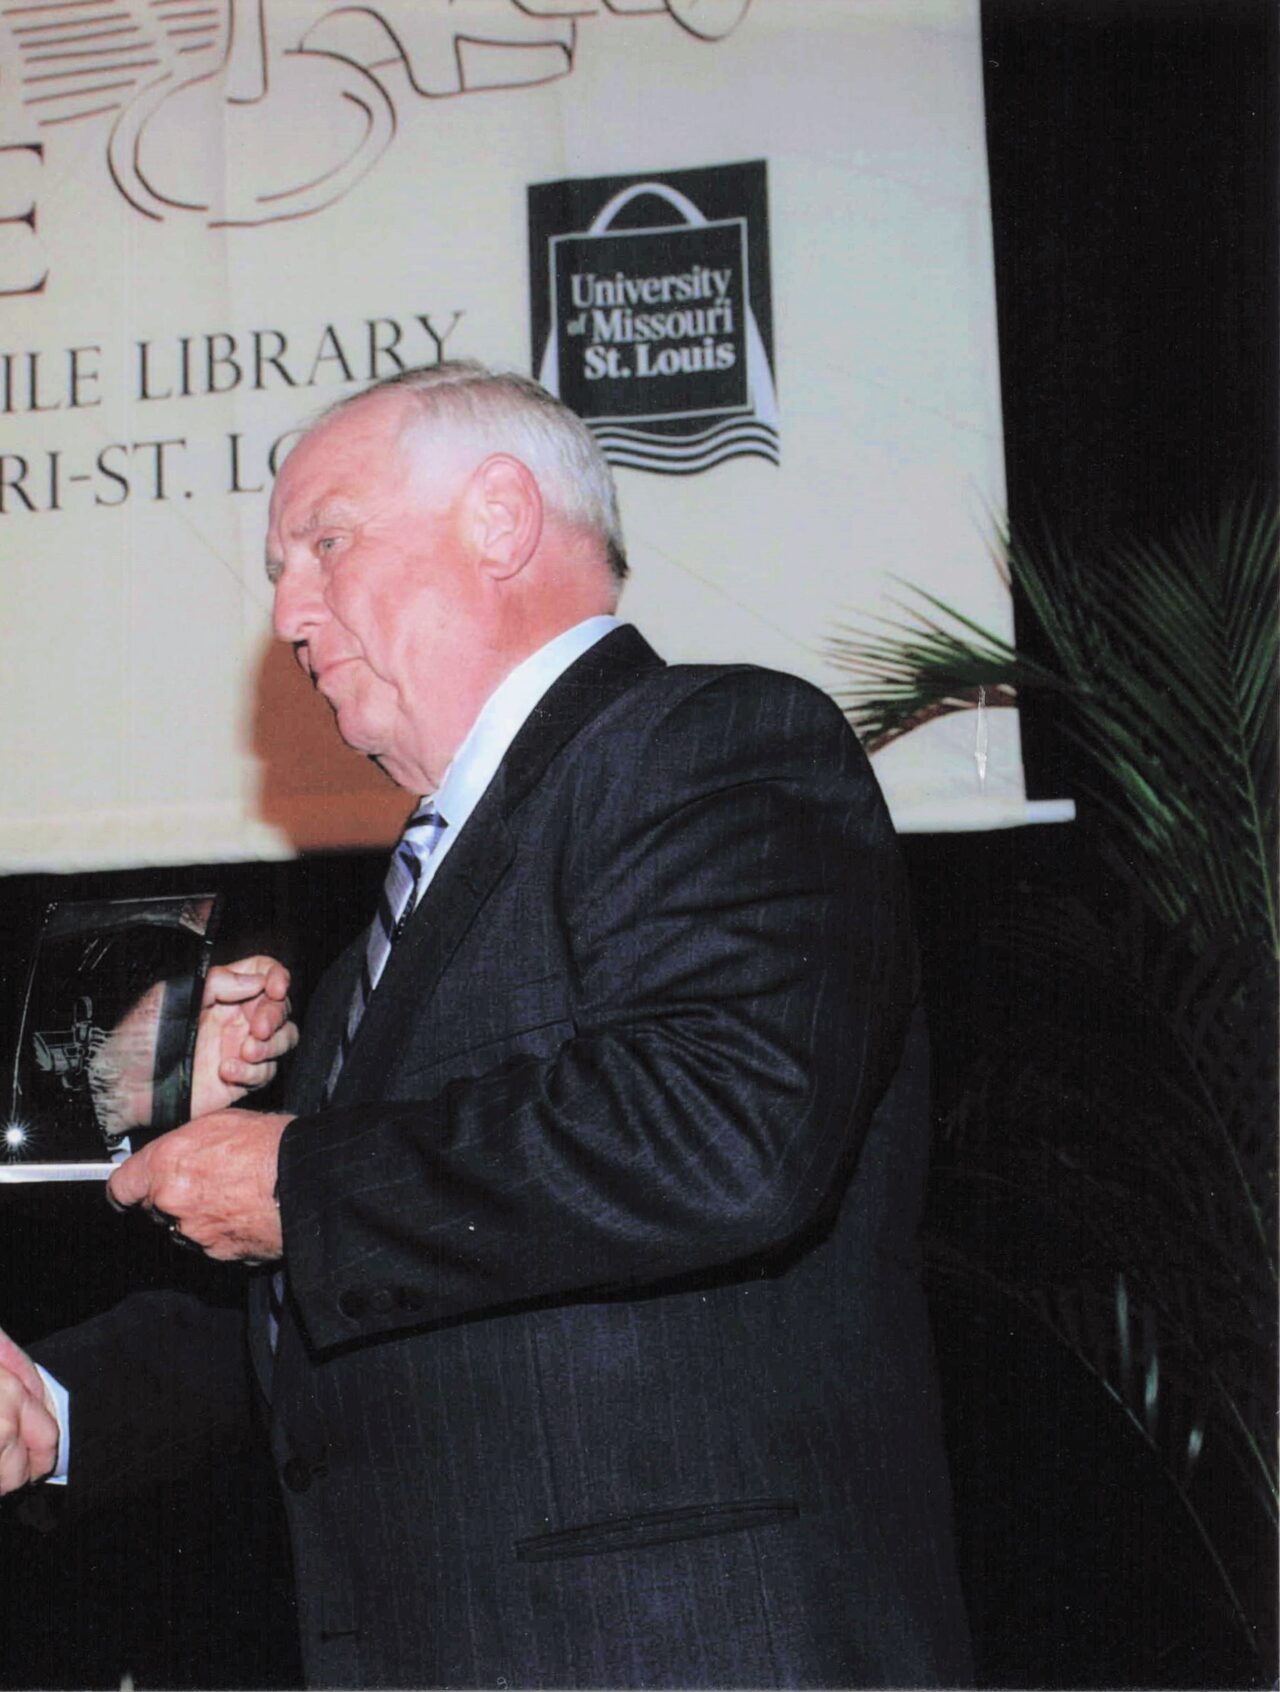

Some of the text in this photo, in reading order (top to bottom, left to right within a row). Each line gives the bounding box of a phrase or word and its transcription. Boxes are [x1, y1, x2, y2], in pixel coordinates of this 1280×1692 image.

[572, 264, 732, 308] University
[591, 298, 734, 344] Missouri
[135, 311, 464, 397] LIBRARY
[584, 336, 736, 380] St. Louis
